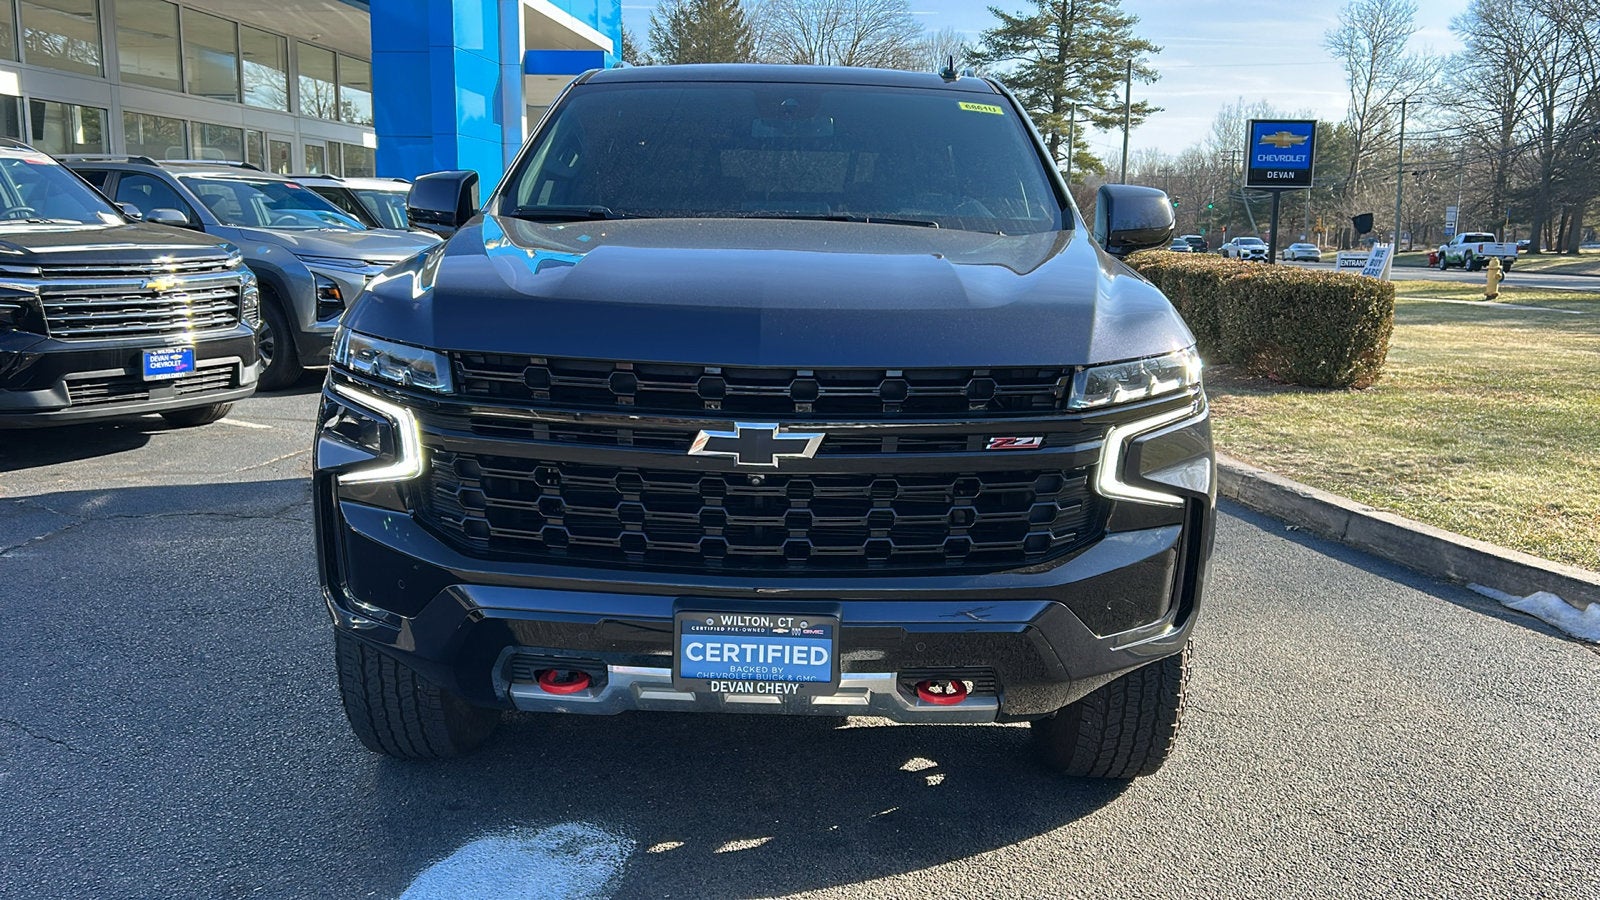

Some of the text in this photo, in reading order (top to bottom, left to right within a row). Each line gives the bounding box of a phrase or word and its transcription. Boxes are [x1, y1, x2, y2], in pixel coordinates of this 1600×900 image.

[1257, 154, 1307, 162] CHEVROLET
[1266, 171, 1295, 179] DEVAN
[1370, 258, 1382, 267] BUY
[150, 360, 182, 369] CHEVROLET
[986, 437, 1043, 449] Z71
[720, 615, 794, 628] WILTON, CT
[686, 642, 828, 665] CERTIFIED
[730, 665, 784, 674] BACKED BY
[755, 673, 785, 681] BUICK
[711, 681, 799, 694] DEVAN CHEVY
